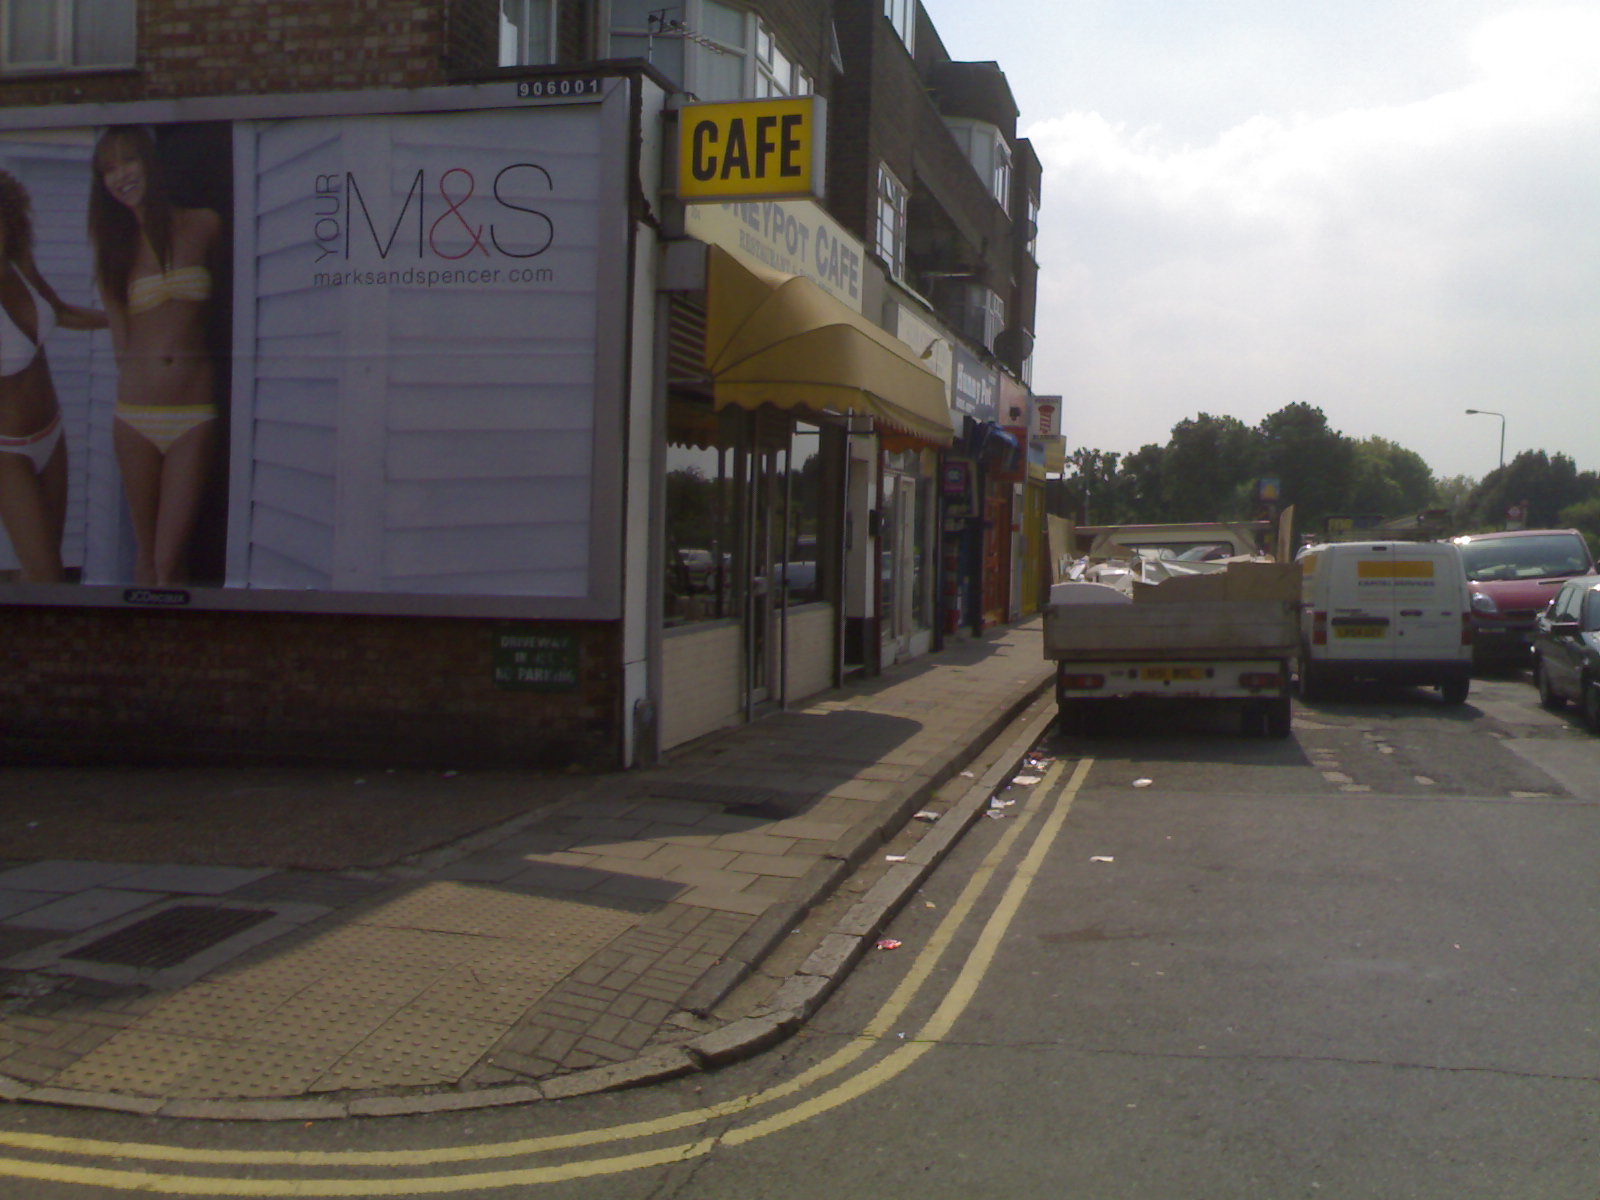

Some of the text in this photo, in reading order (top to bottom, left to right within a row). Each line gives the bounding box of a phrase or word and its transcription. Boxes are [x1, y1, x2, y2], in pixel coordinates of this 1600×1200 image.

[518, 79, 599, 97] 906001
[692, 114, 802, 181] CAFE
[314, 173, 340, 263] YOUR
[345, 163, 554, 260] M&S
[313, 267, 553, 287] marksandspencer.com
[815, 225, 859, 300] CAFE
